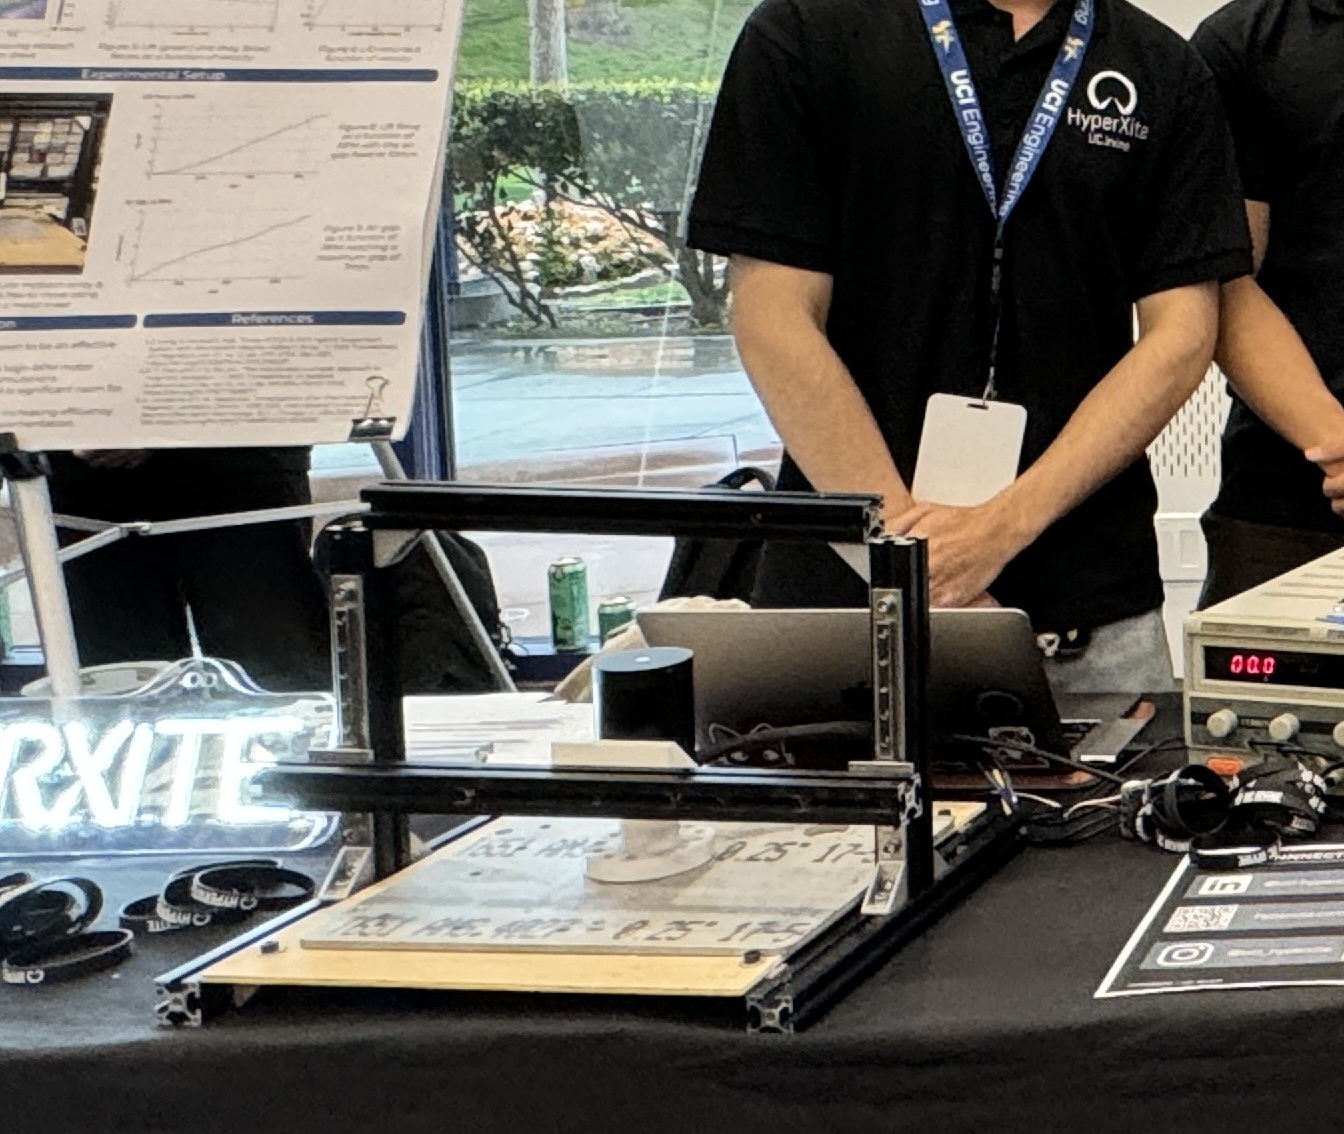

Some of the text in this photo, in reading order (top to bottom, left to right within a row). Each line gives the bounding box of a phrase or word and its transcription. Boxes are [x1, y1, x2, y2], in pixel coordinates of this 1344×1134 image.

[81, 68, 226, 82] Experimental Setup
[950, 69, 975, 106] UCI
[1042, 79, 1070, 112] UCI
[1066, 107, 1150, 140] HyperXite
[1088, 131, 1103, 146] UC
[231, 311, 315, 325] References
[1207, 879, 1242, 892] in
